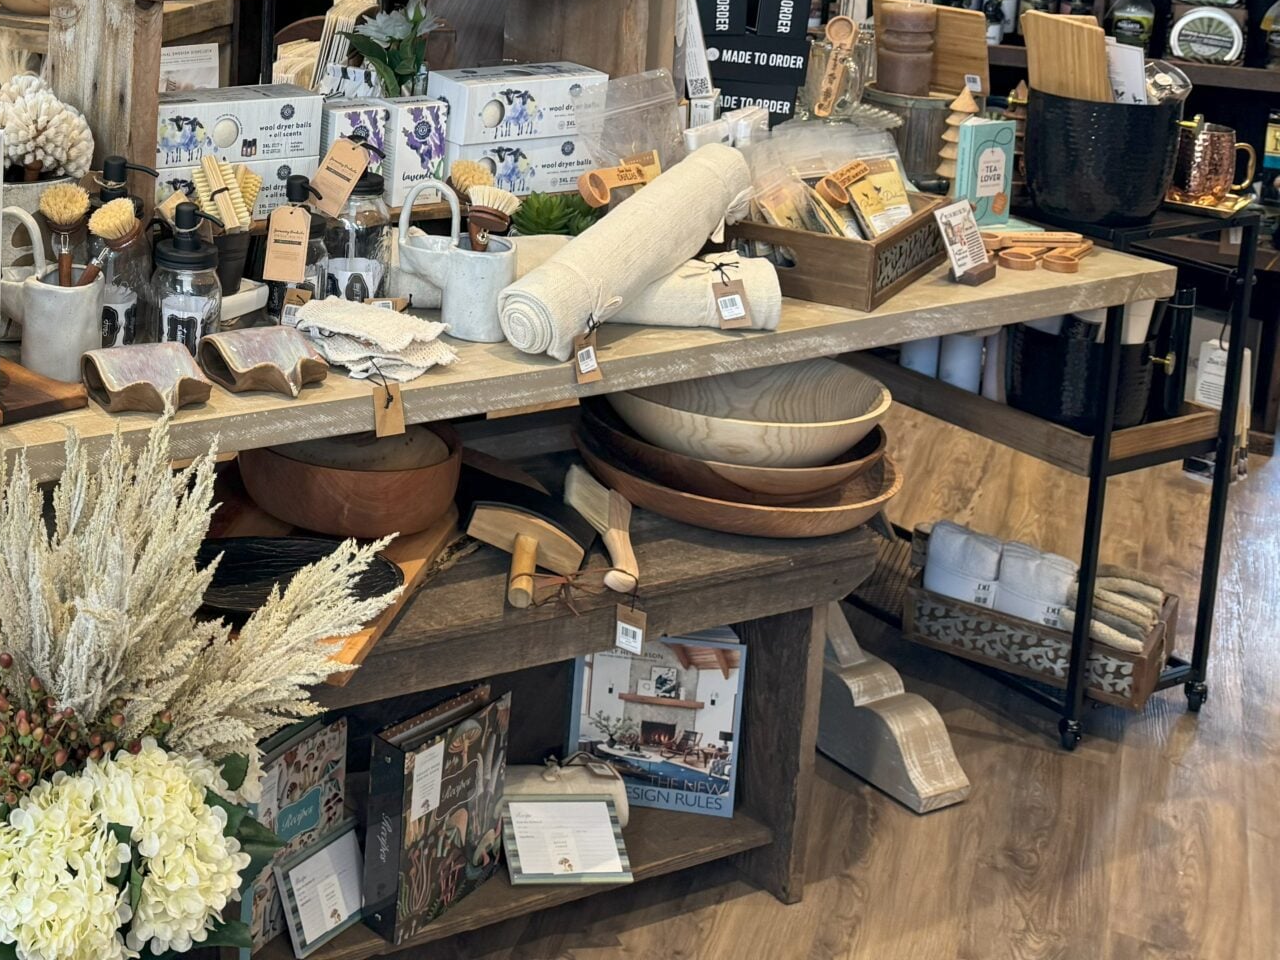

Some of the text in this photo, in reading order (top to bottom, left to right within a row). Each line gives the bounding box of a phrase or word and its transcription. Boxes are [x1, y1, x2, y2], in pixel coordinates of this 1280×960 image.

[776, 0, 795, 33] ORDER
[721, 49, 804, 69] MADE TO ORDER
[549, 104, 565, 112] wool
[719, 95, 790, 114] ADE TO ORDER
[260, 121, 312, 132] wool dryer balls
[541, 159, 592, 170] wool dryer balls
[984, 165, 998, 173] TEA
[402, 171, 435, 183] lavende
[980, 173, 1002, 183] LOVER
[440, 776, 472, 801] Recipes
[648, 775, 723, 795] THE NEW
[626, 785, 723, 810] ESIGN RULES
[281, 805, 314, 831] Recipes
[377, 813, 394, 863] Recipes
